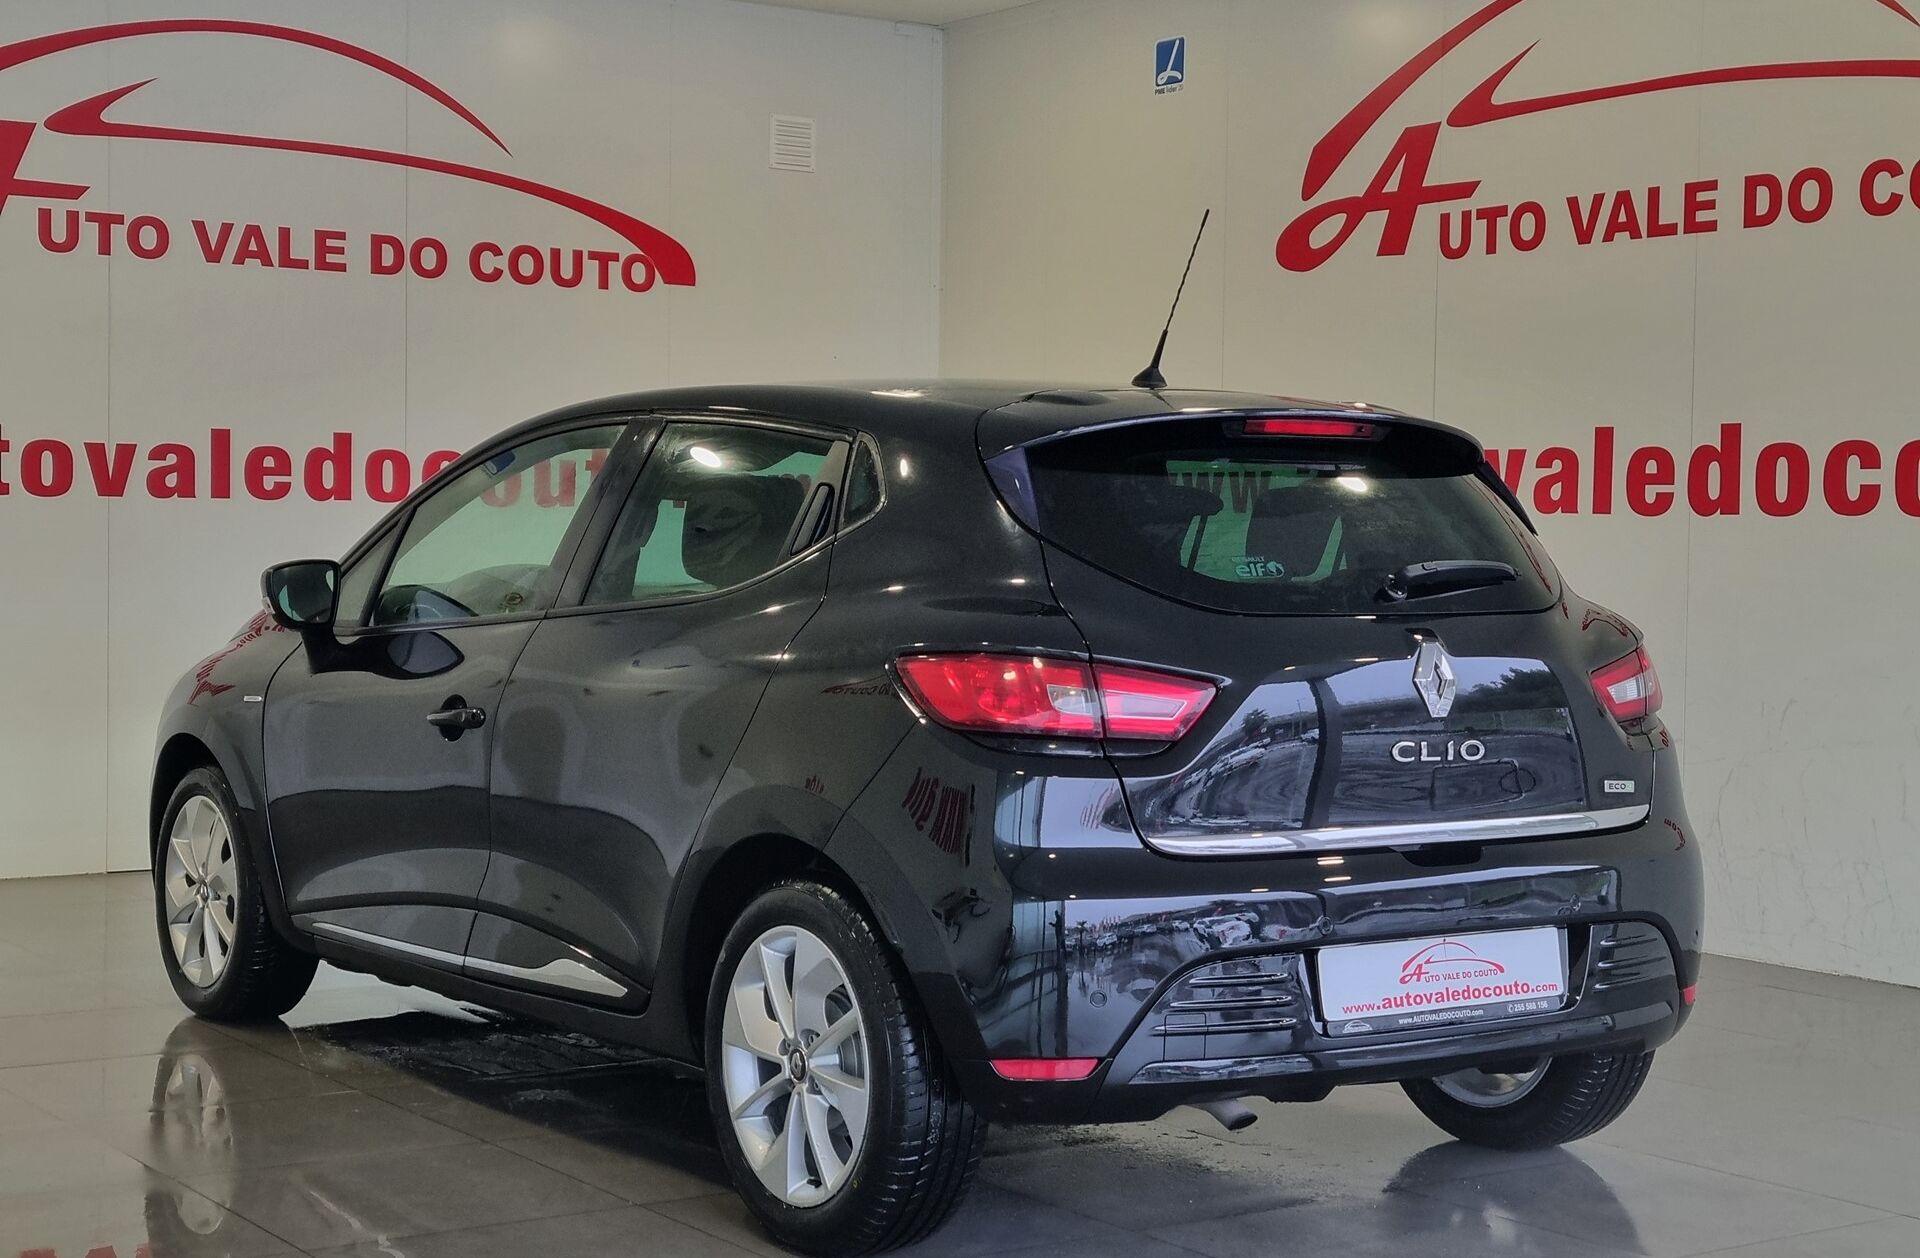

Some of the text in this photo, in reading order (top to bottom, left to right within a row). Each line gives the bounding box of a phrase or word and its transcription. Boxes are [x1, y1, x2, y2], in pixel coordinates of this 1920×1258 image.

[1276, 121, 1920, 272] AUTO VALE DO C
[191, 219, 347, 273] VALE
[370, 233, 448, 279] DO
[468, 241, 656, 293] COUTO
[1391, 739, 1486, 762] CLIO
[1399, 963, 1499, 985] AUTO VALE DO COUTO
[1342, 980, 1558, 1014] www.autovaledocouto.com
